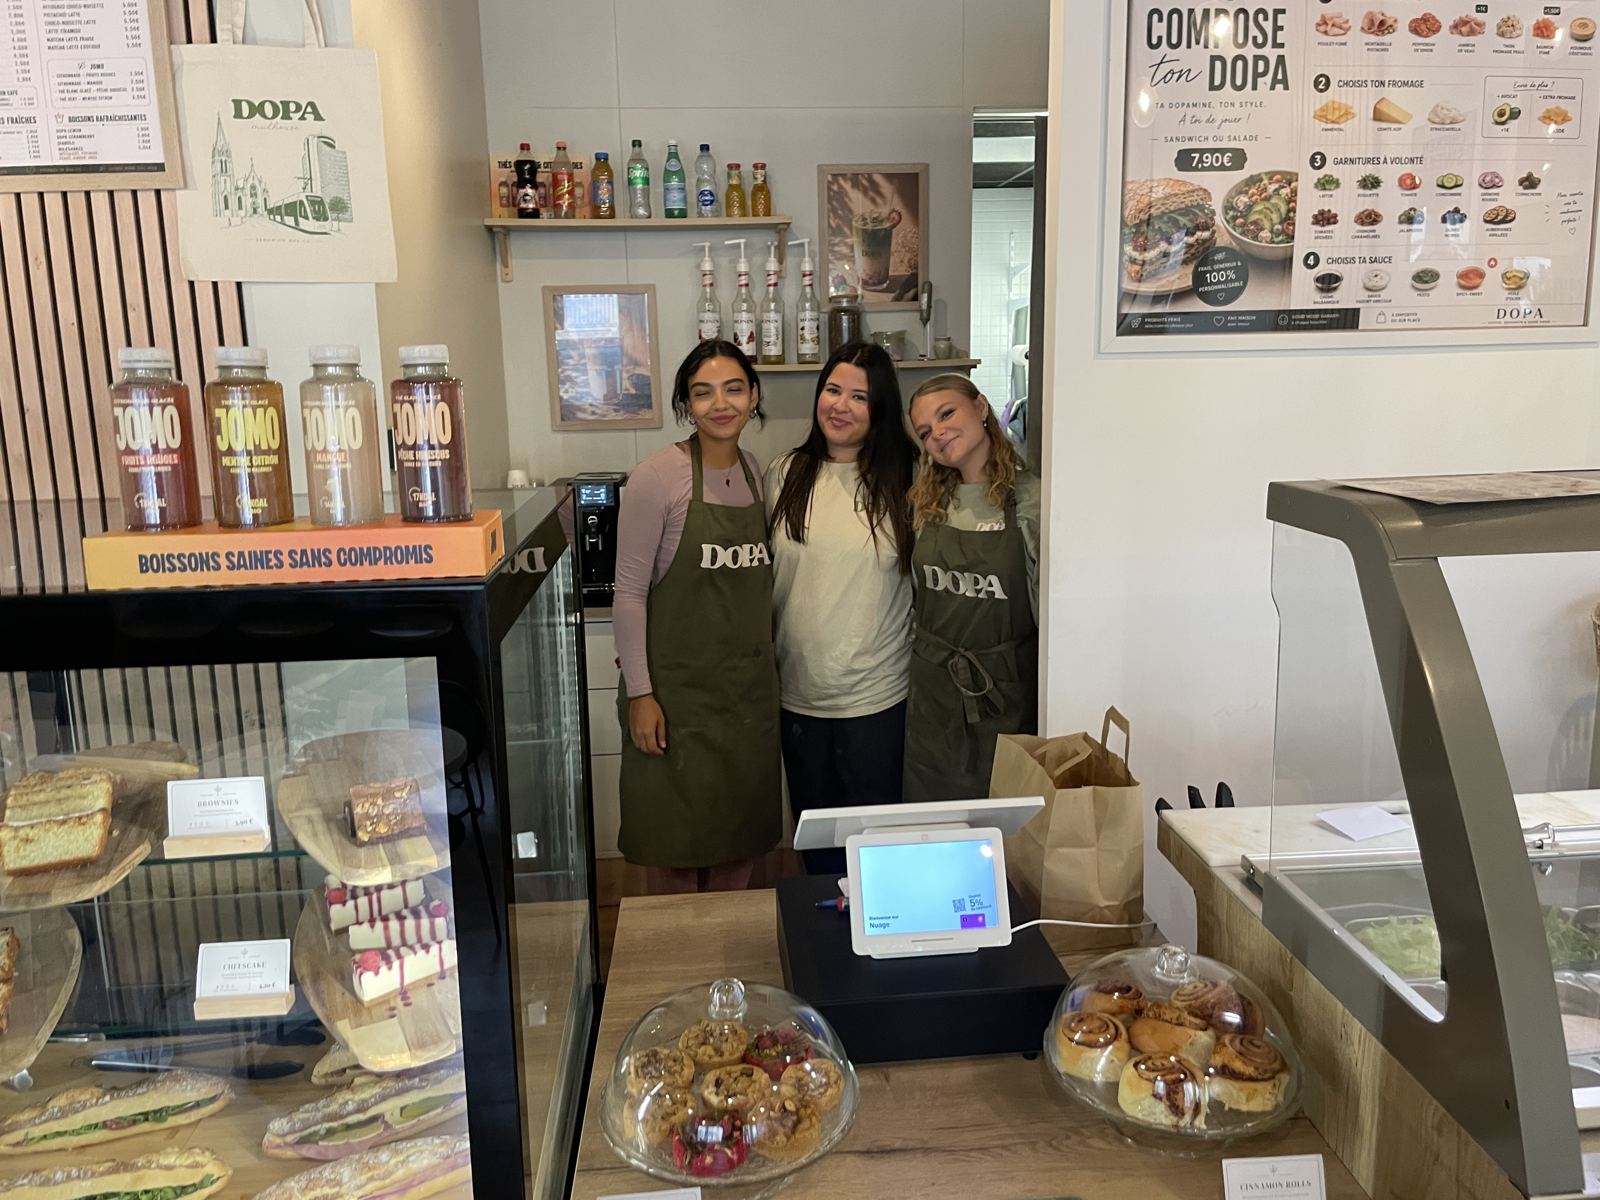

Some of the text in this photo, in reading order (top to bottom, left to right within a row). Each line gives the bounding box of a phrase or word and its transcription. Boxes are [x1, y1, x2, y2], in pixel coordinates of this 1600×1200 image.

[1146, 7, 1287, 50] COMPOSE
[1148, 53, 1290, 92] ton DOPA
[1318, 77, 1424, 89] 2 CHOISIS TON FROMAGE
[232, 98, 326, 122] DOPA
[1168, 101, 1215, 110] DOPAMINE,
[7, 114, 37, 124] FRAÎCHES
[68, 115, 94, 123] BOISSONS
[1190, 112, 1202, 125] toi
[1205, 113, 1217, 125] de
[1217, 115, 1242, 130] jouer
[1164, 134, 1259, 143] SANDWICH OU SALADE
[1190, 152, 1233, 169] 7,90€
[1314, 155, 1321, 167] 3
[1333, 156, 1381, 166] GARNITURES
[1390, 155, 1424, 165] VOLONTÉ
[1307, 255, 1393, 266] 4 CHOISIS TA SAUCE
[1205, 269, 1236, 284] 100%
[1198, 280, 1244, 293] PERSONNALISABLE
[1496, 307, 1544, 319] DOPA
[113, 405, 182, 451] JOMO
[214, 406, 281, 451] JOMO
[302, 407, 363, 451] JOMO
[393, 401, 452, 446] JOMO
[252, 454, 279, 466] CITRON
[138, 543, 434, 574] BOISSONS SAINES SANS COMPROMIS
[700, 542, 771, 569] DOPA
[923, 564, 1008, 600] DOPA
[197, 799, 239, 808] BROWNIES
[969, 898, 983, 908] 5%
[223, 962, 265, 970] CHEESCAKE
[1240, 1180, 1311, 1191] CINNAMON ROLLS
